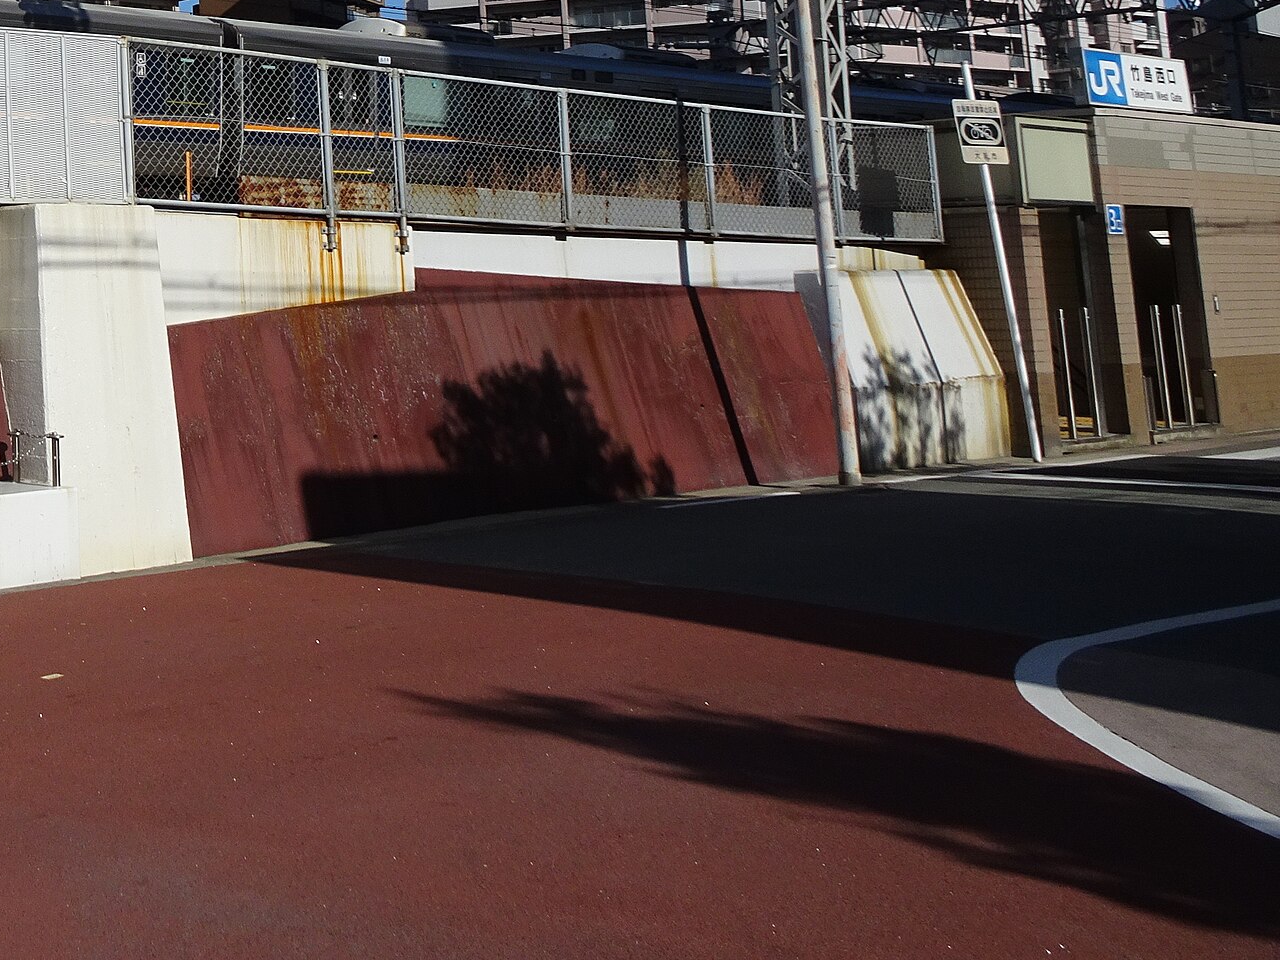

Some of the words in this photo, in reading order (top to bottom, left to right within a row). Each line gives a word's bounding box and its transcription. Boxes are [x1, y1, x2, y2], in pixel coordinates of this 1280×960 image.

[1089, 60, 1125, 97] JR
[1130, 64, 1176, 84] 竹島西口
[1155, 90, 1169, 101] West
[1170, 92, 1183, 102] Gate
